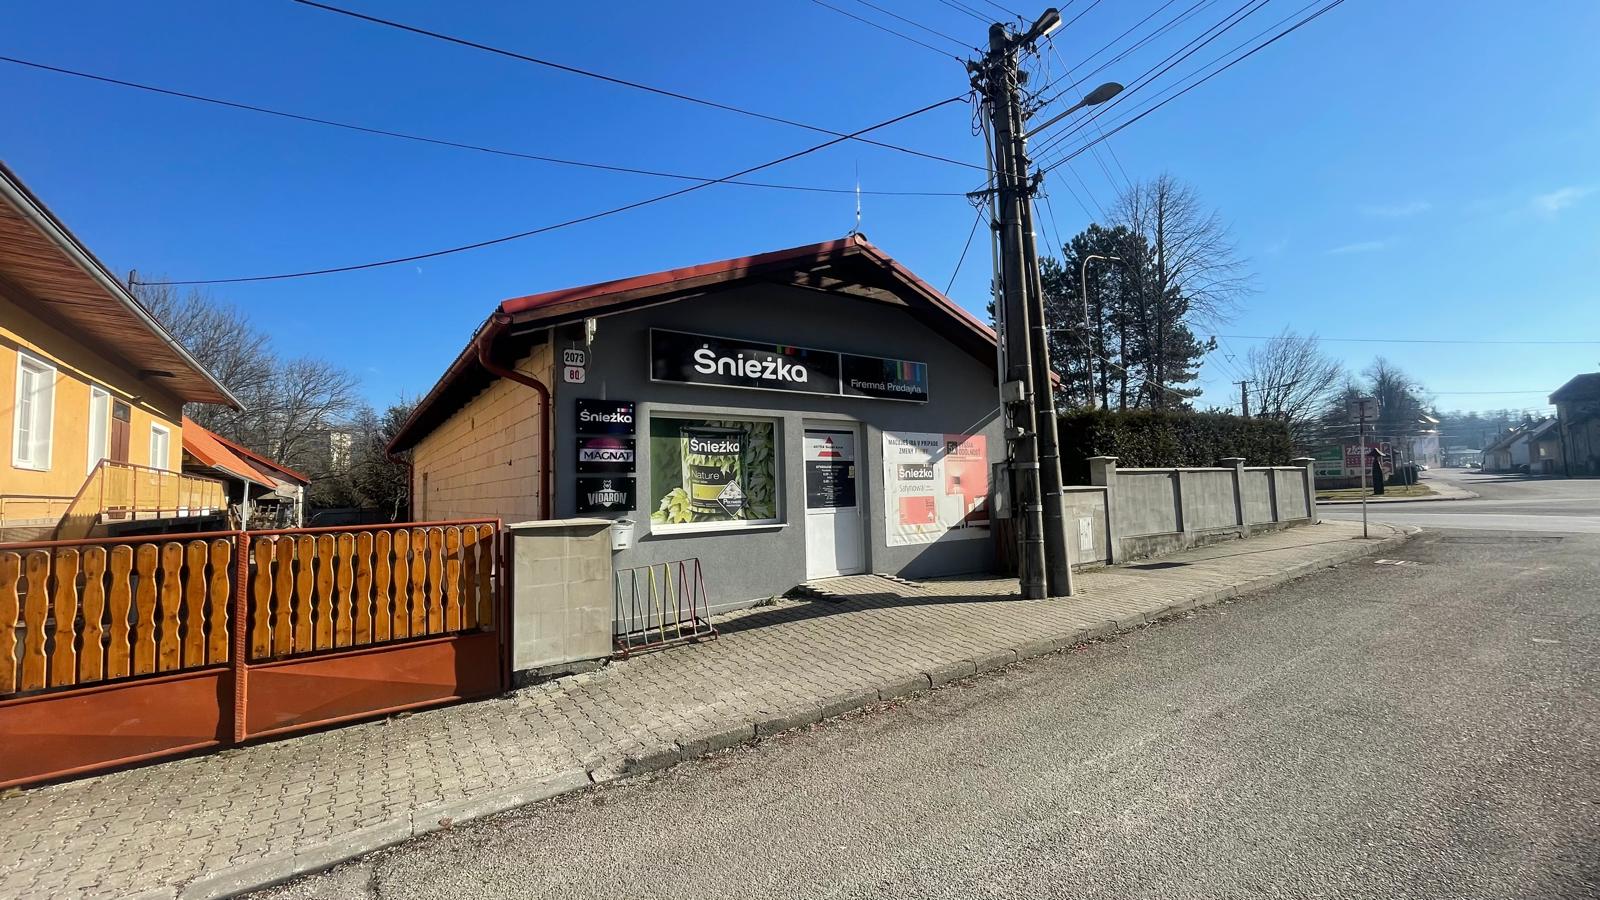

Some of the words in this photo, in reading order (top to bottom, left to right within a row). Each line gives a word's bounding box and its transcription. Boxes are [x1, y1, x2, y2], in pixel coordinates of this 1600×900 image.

[565, 351, 584, 363] 2073
[693, 343, 808, 383] Śnieżka
[850, 378, 886, 391] Firemná
[580, 408, 632, 423] Śnieżka
[690, 437, 740, 453] Śnieżka
[691, 469, 720, 480] Nature
[587, 492, 627, 506] VIDARON
